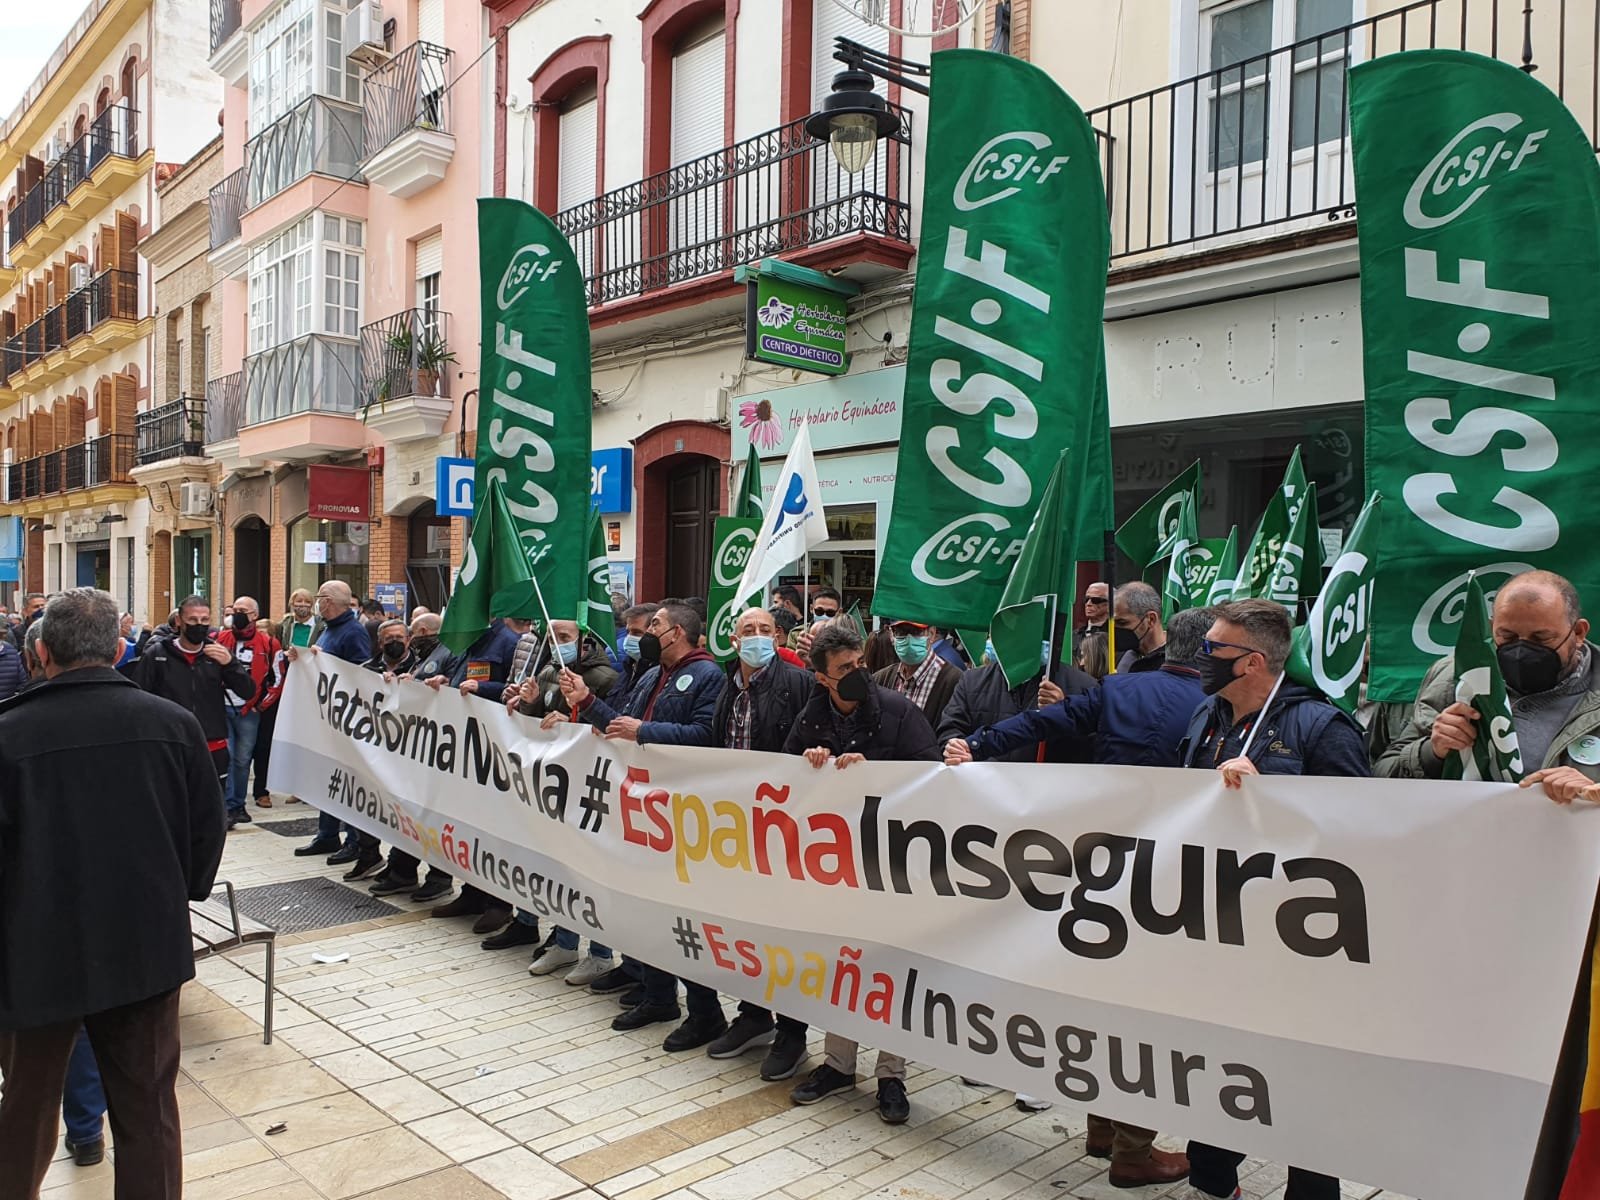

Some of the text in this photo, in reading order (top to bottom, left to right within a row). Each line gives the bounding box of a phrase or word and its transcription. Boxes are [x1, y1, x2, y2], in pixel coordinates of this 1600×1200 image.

[797, 303, 846, 325] Herbolario
[765, 338, 798, 354] CENTRO
[841, 398, 897, 425] Equinácea
[863, 474, 897, 485] NUTRICIÓ
[317, 504, 360, 513] PRONOVIAS
[317, 671, 457, 774] Plataforma
[672, 916, 1273, 1126] #EspañaInsegura
